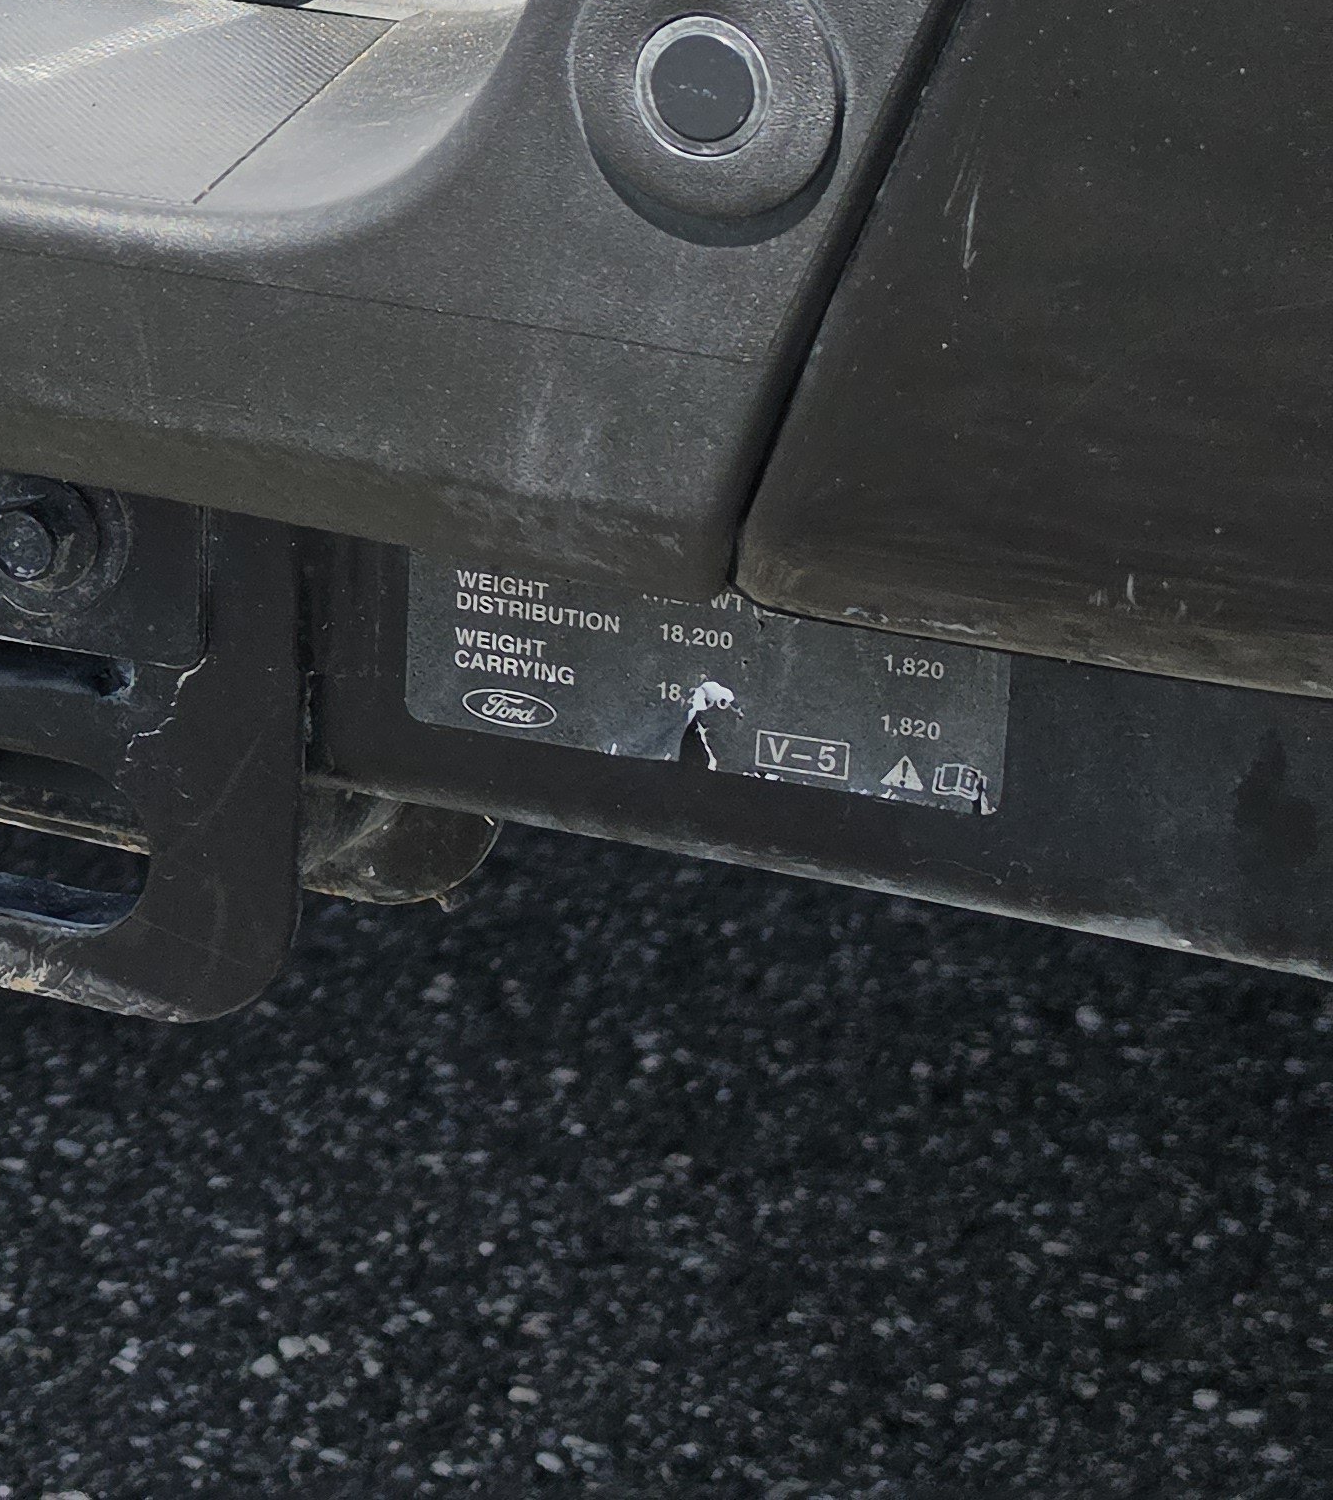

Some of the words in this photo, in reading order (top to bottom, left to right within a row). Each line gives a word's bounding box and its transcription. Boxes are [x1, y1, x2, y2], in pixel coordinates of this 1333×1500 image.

[456, 569, 550, 600] WEIGHT
[455, 591, 621, 634] DISTRIBUTION
[454, 626, 548, 658] WEIGHT
[659, 623, 734, 650] 18,200
[453, 649, 575, 686] CARRYING
[882, 654, 945, 681] 1,820
[880, 713, 942, 741] 1,820
